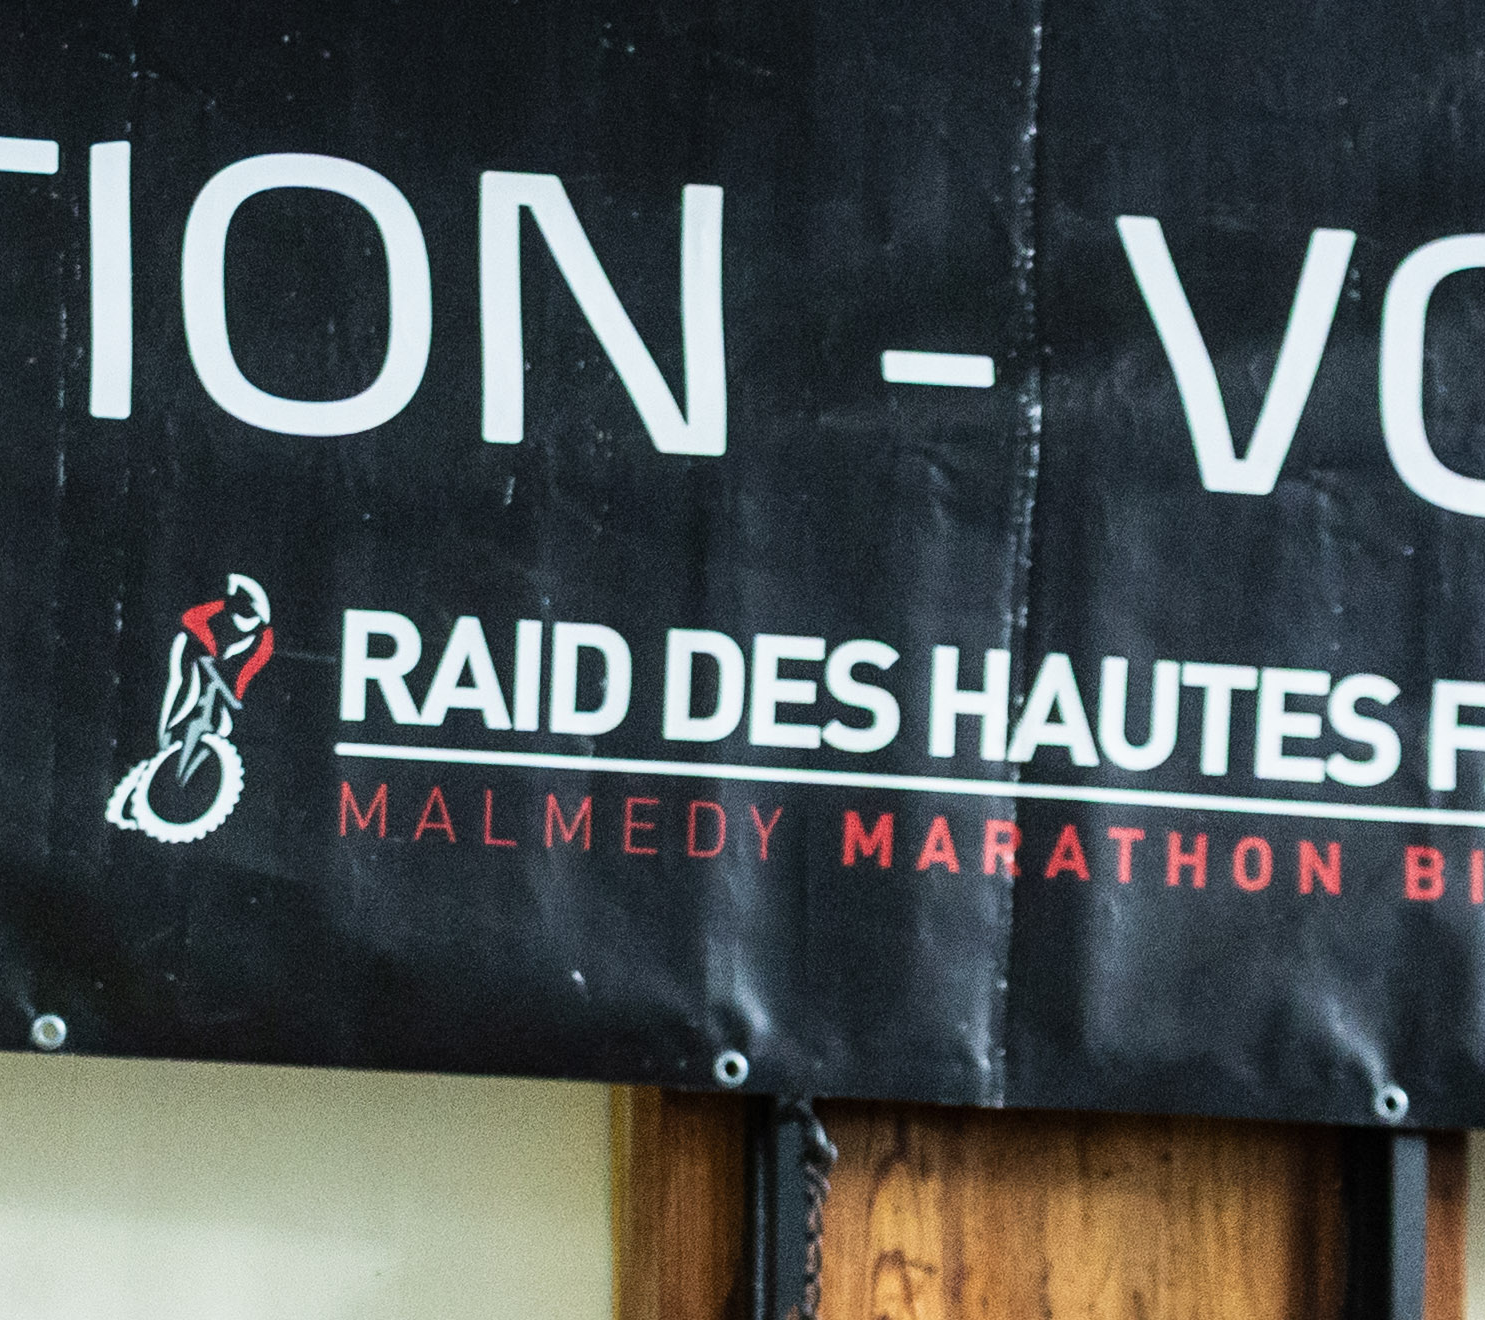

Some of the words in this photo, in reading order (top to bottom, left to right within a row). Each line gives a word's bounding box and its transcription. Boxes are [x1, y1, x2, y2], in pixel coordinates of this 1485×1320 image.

[340, 609, 631, 735] RAID
[664, 629, 900, 750] DES
[928, 645, 1402, 786] HAUTES
[340, 782, 781, 860] MALMEDY
[842, 811, 1340, 894] MARATHON
